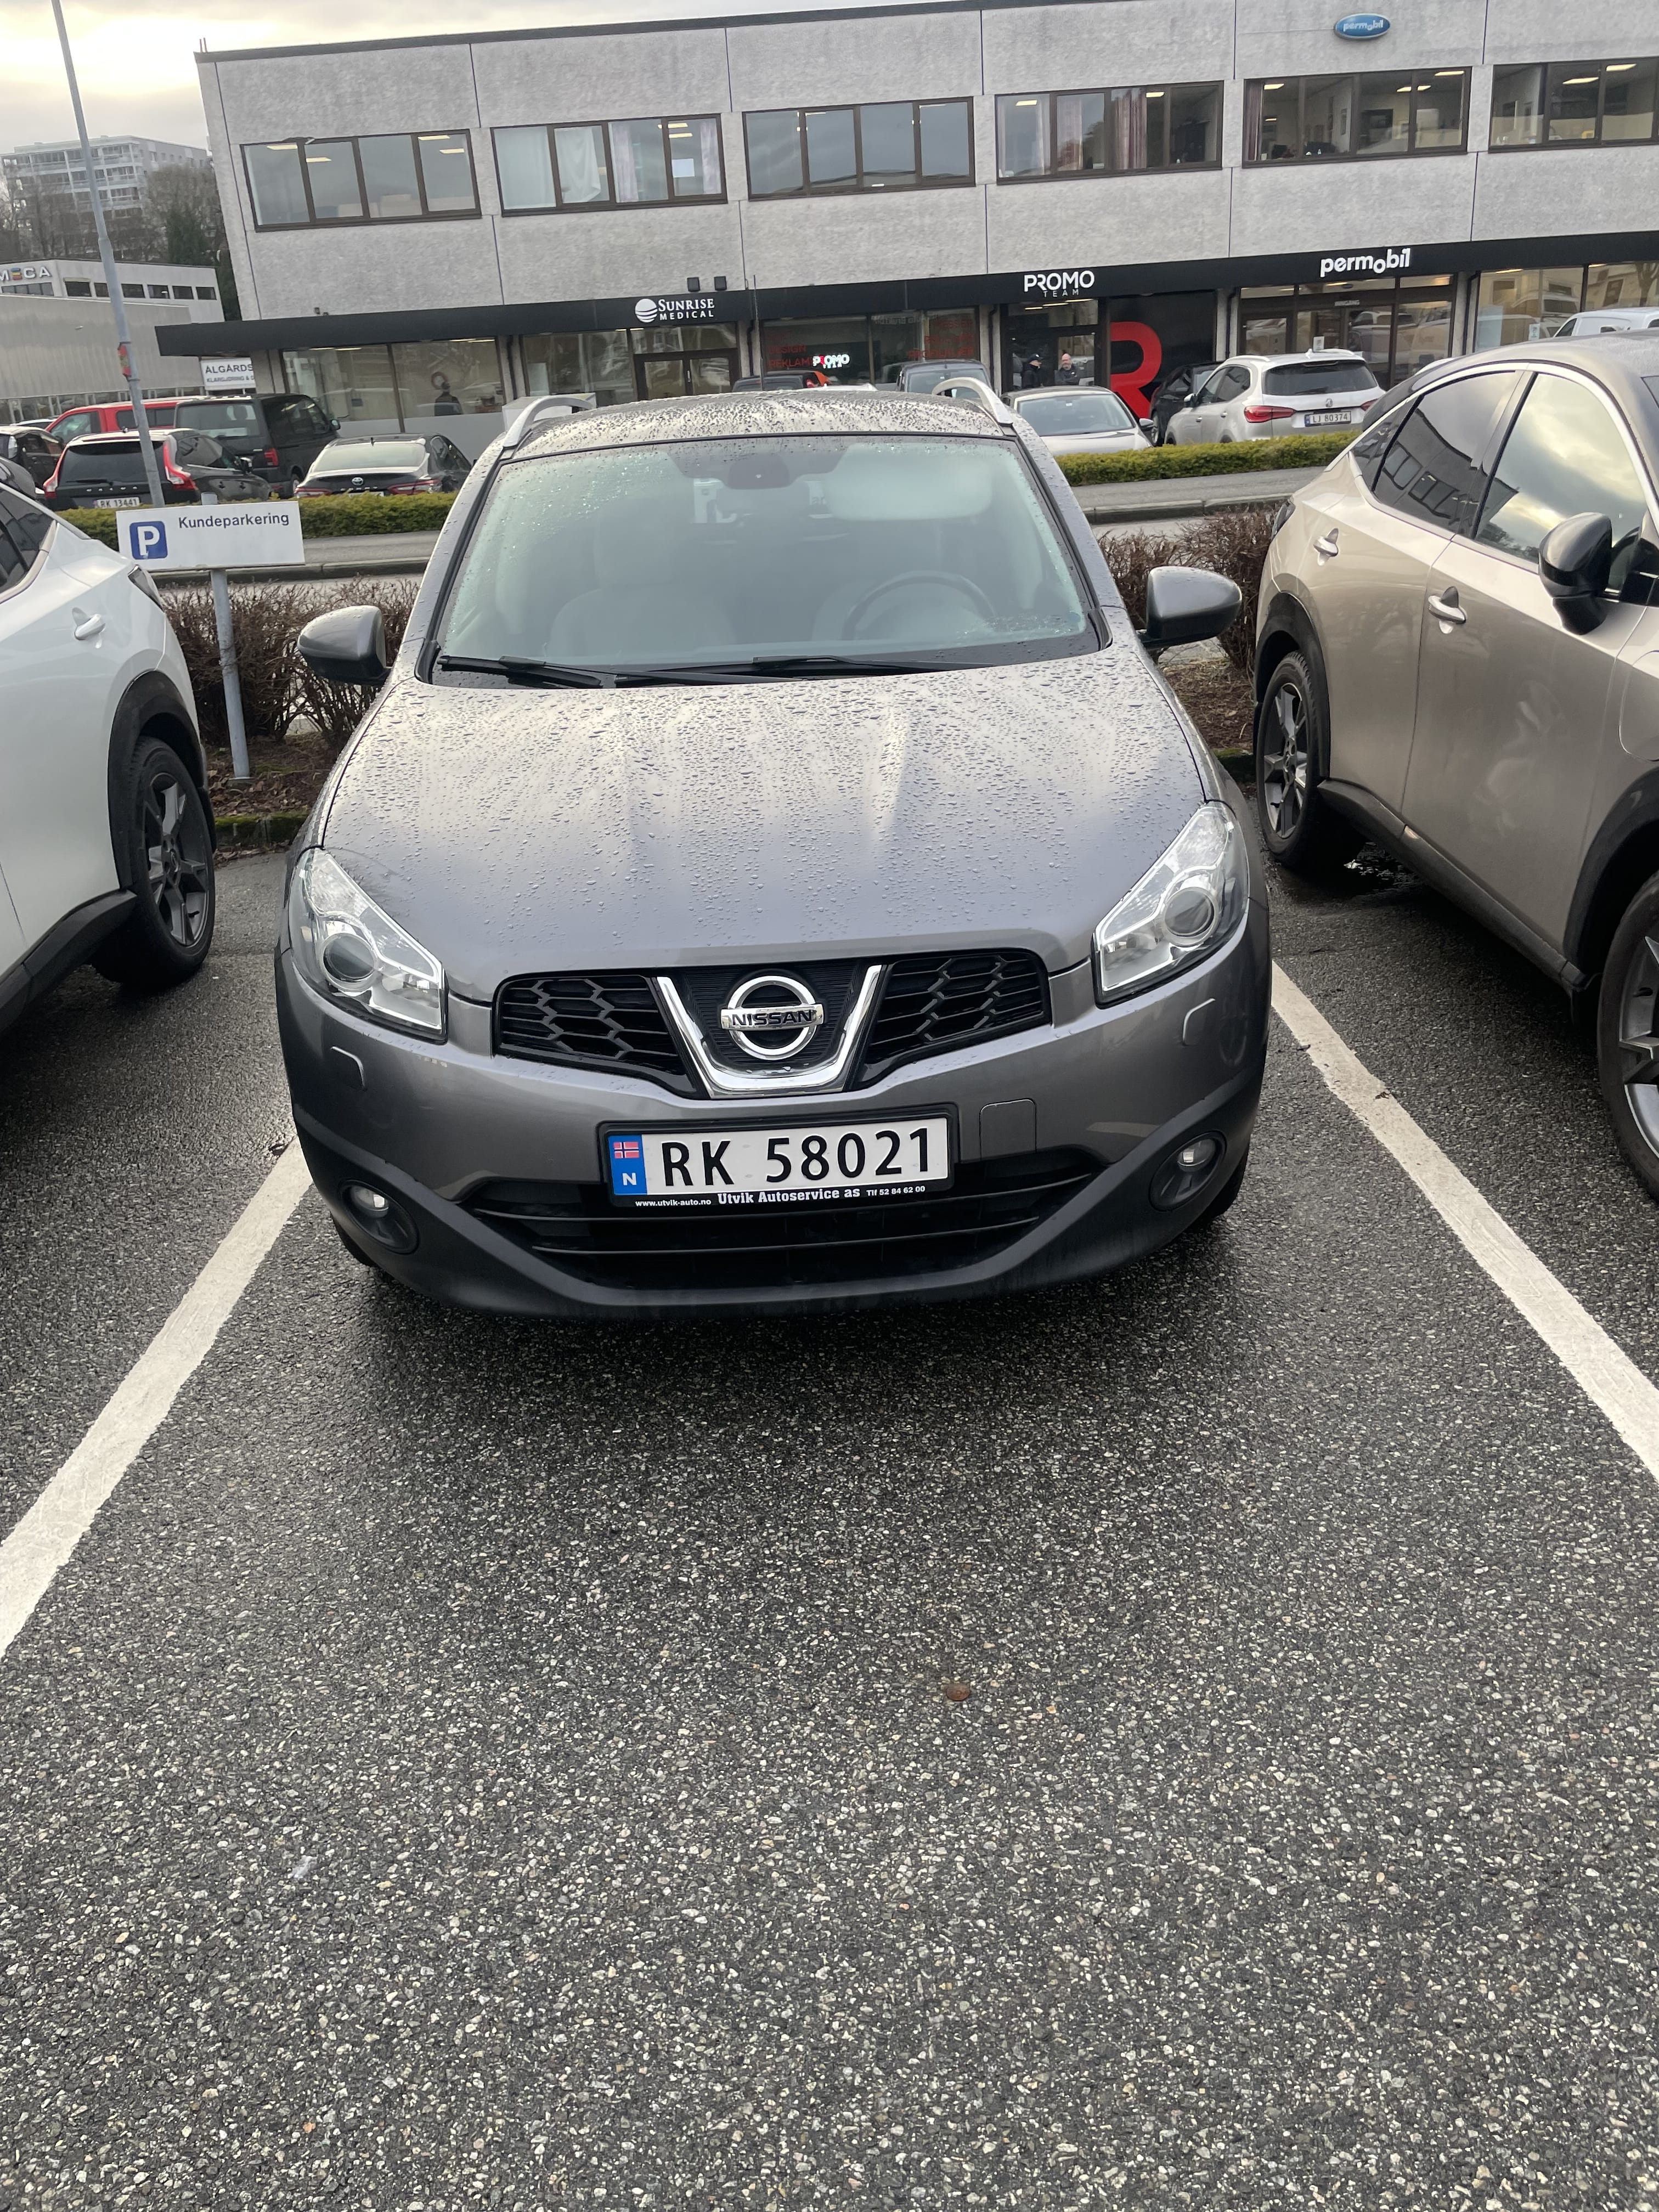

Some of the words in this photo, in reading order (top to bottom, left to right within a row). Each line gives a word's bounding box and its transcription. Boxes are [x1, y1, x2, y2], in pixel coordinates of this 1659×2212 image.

[1343, 19, 1384, 32] permobil
[1320, 247, 1411, 278] permobil
[1024, 270, 1095, 292] PROMO
[1043, 289, 1079, 297] TEAM
[658, 298, 715, 312] SUNRISE
[659, 310, 714, 321] MEDICAL
[812, 354, 850, 367] PROMO
[1312, 415, 1321, 423] LJ
[1324, 413, 1348, 422] 80374
[179, 512, 289, 528] Kundeparkering
[137, 526, 160, 556] P
[732, 1009, 812, 1026] NISSAN
[662, 1141, 734, 1186] RK
[766, 1127, 928, 1183] 58021
[622, 1172, 637, 1186] N
[717, 1193, 754, 1205] Utvik
[758, 1188, 840, 1203] Autoservice
[844, 1188, 860, 1198] as
